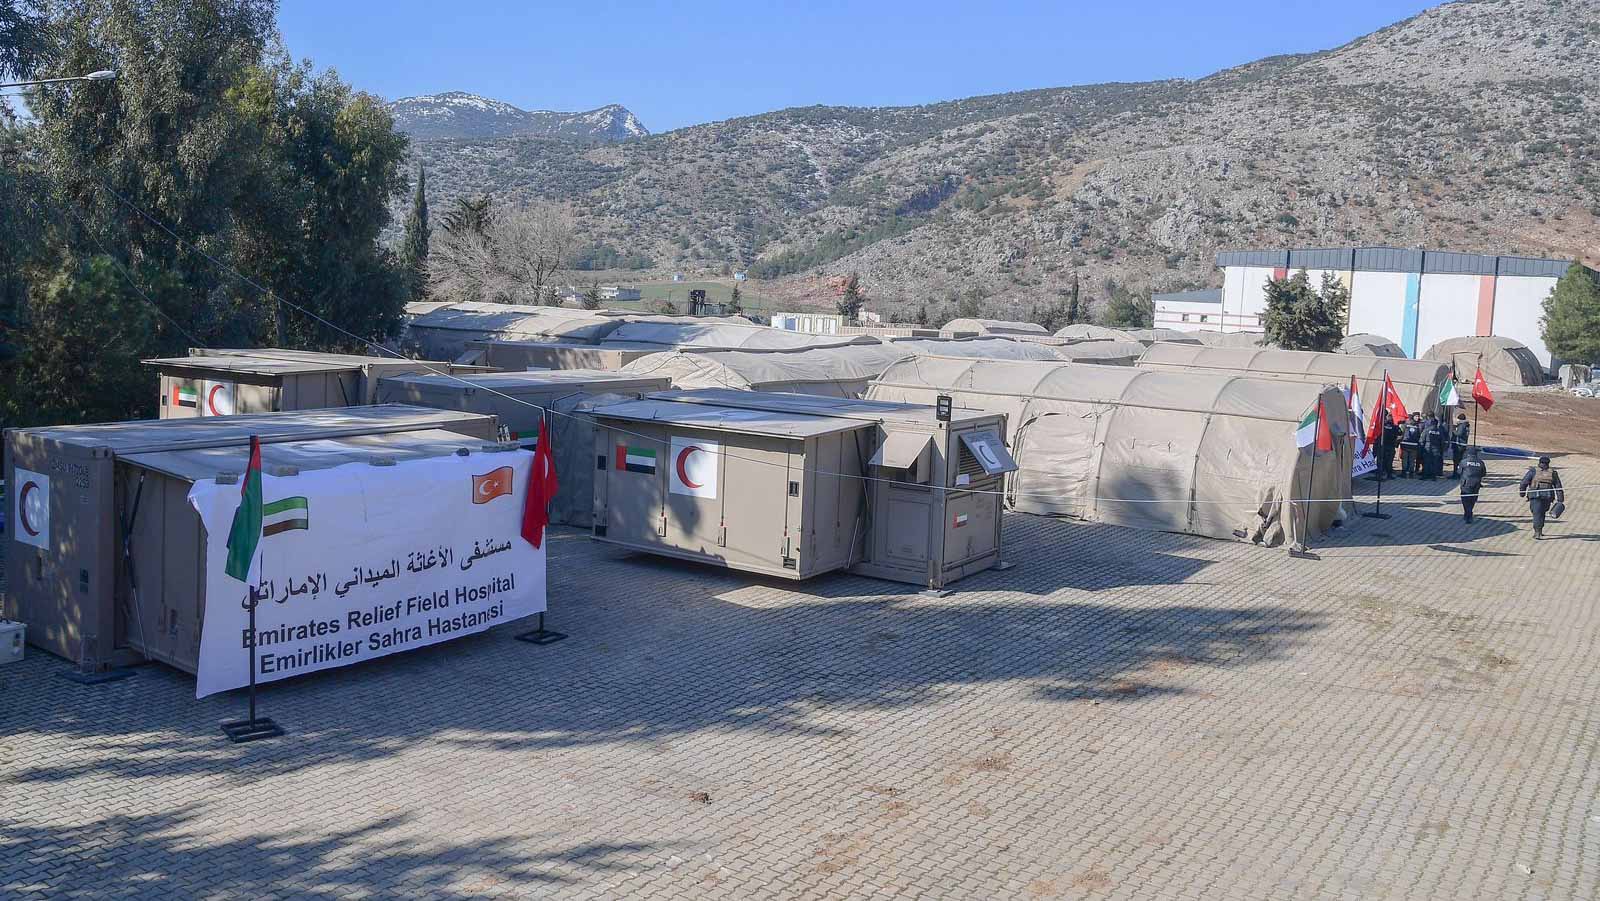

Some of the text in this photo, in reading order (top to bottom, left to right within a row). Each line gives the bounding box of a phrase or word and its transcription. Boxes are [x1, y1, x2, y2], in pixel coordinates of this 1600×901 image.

[460, 538, 512, 571] مستشفى
[335, 559, 400, 598] الميداني
[242, 573, 515, 649] Emirates Relief Field Hospital
[260, 640, 362, 674] Emirlikler
[368, 626, 422, 651] Sahra
